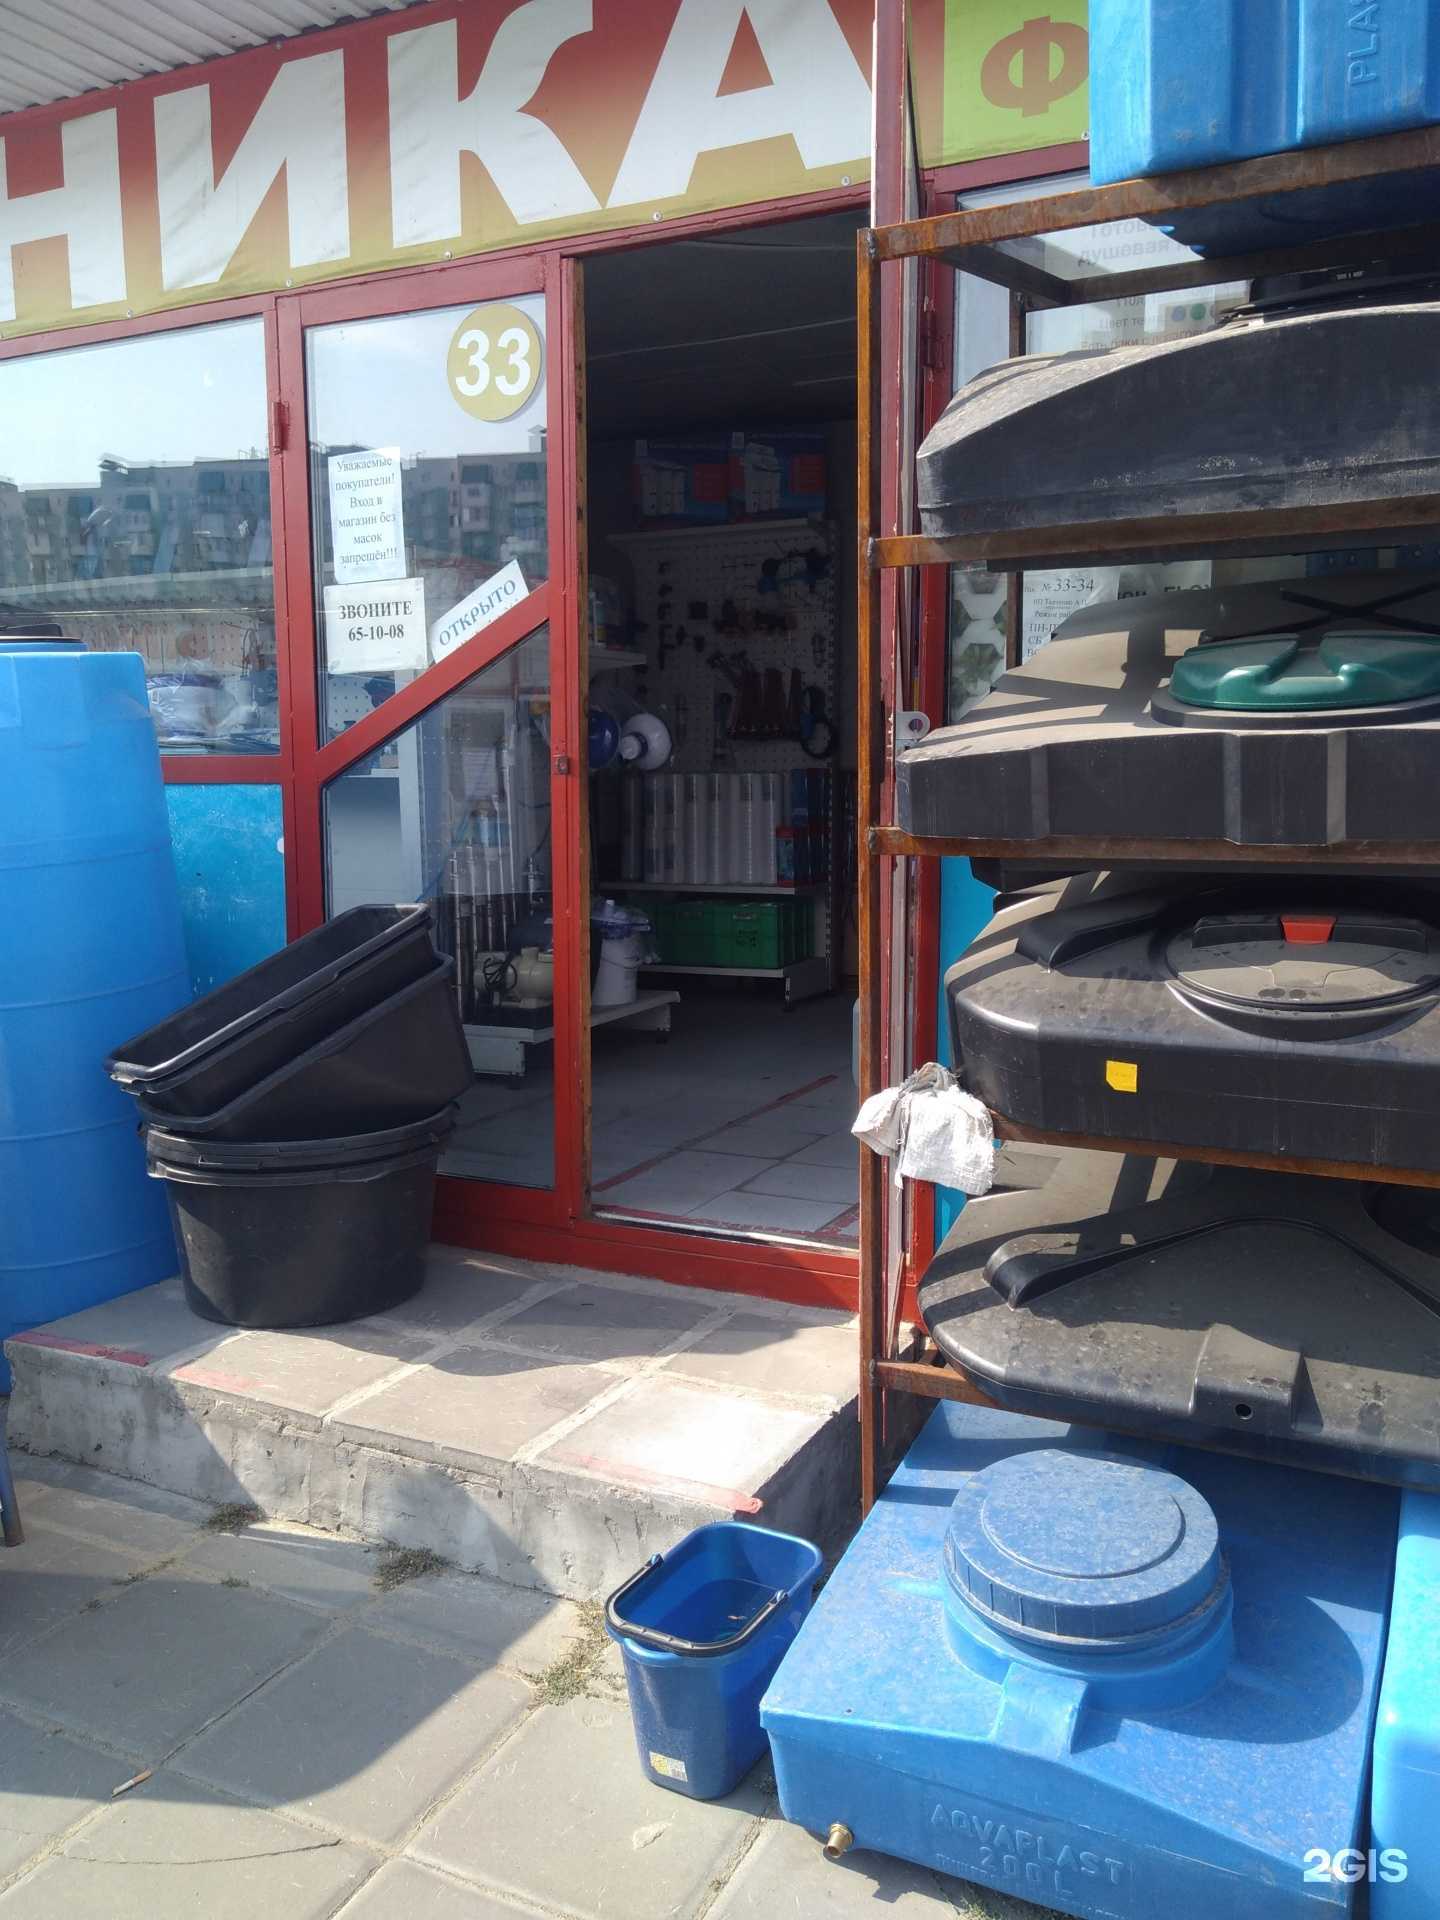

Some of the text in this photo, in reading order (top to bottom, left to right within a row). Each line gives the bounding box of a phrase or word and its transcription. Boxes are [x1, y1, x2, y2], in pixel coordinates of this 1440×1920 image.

[455, 329, 531, 397] 33
[336, 457, 392, 473] Уважаемые
[335, 473, 395, 491] покупатели!
[350, 496, 383, 508] Вход в
[338, 512, 396, 528] магазин без
[353, 532, 382, 545] масок
[1053, 577, 1095, 593] 33-34
[338, 600, 413, 620] ЗВОНИТЕ
[439, 579, 516, 646] ОТКРЫТО
[349, 624, 405, 642] 65-10-08
